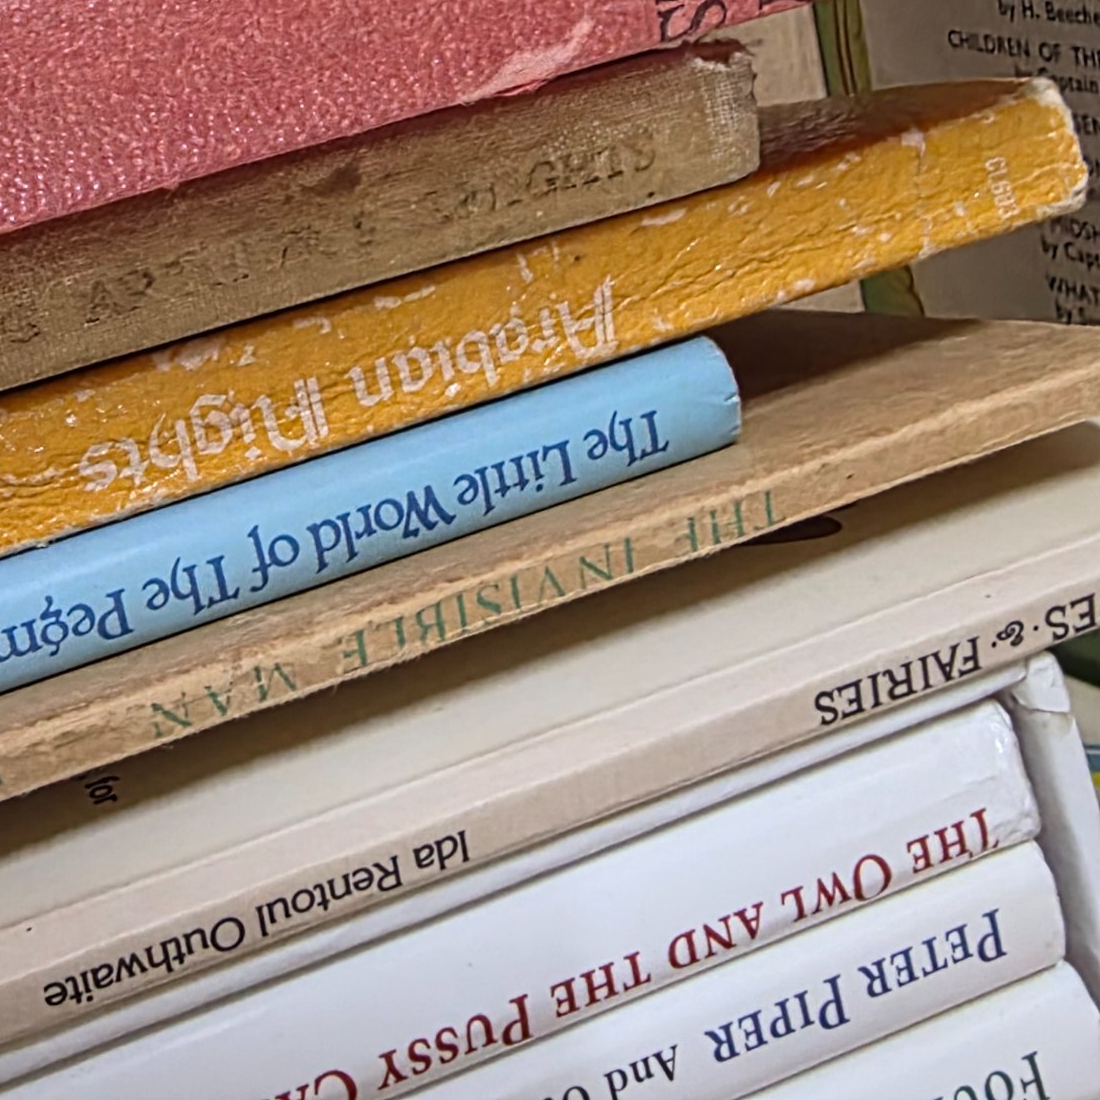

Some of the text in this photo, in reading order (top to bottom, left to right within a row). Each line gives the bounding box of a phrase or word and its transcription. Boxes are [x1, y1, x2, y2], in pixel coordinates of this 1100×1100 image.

[1038, 42, 1061, 63] OF
[79, 275, 619, 493] Arabian Nights
[585, 409, 669, 469] The
[453, 439, 579, 515] Little
[248, 524, 301, 594] of
[307, 485, 457, 574] World
[142, 555, 240, 616] The
[338, 535, 638, 674] INVISIBLE
[814, 635, 982, 726] FAIRIES
[905, 808, 1001, 876] THE
[43, 829, 471, 1009] Ida Rentoul Outhwaite
[781, 853, 893, 924] OWL
[668, 901, 764, 969] AND
[550, 949, 654, 1019] THE
[603, 908, 1009, 1100] PETER PIPER And
[377, 994, 535, 1090] PUSSY
